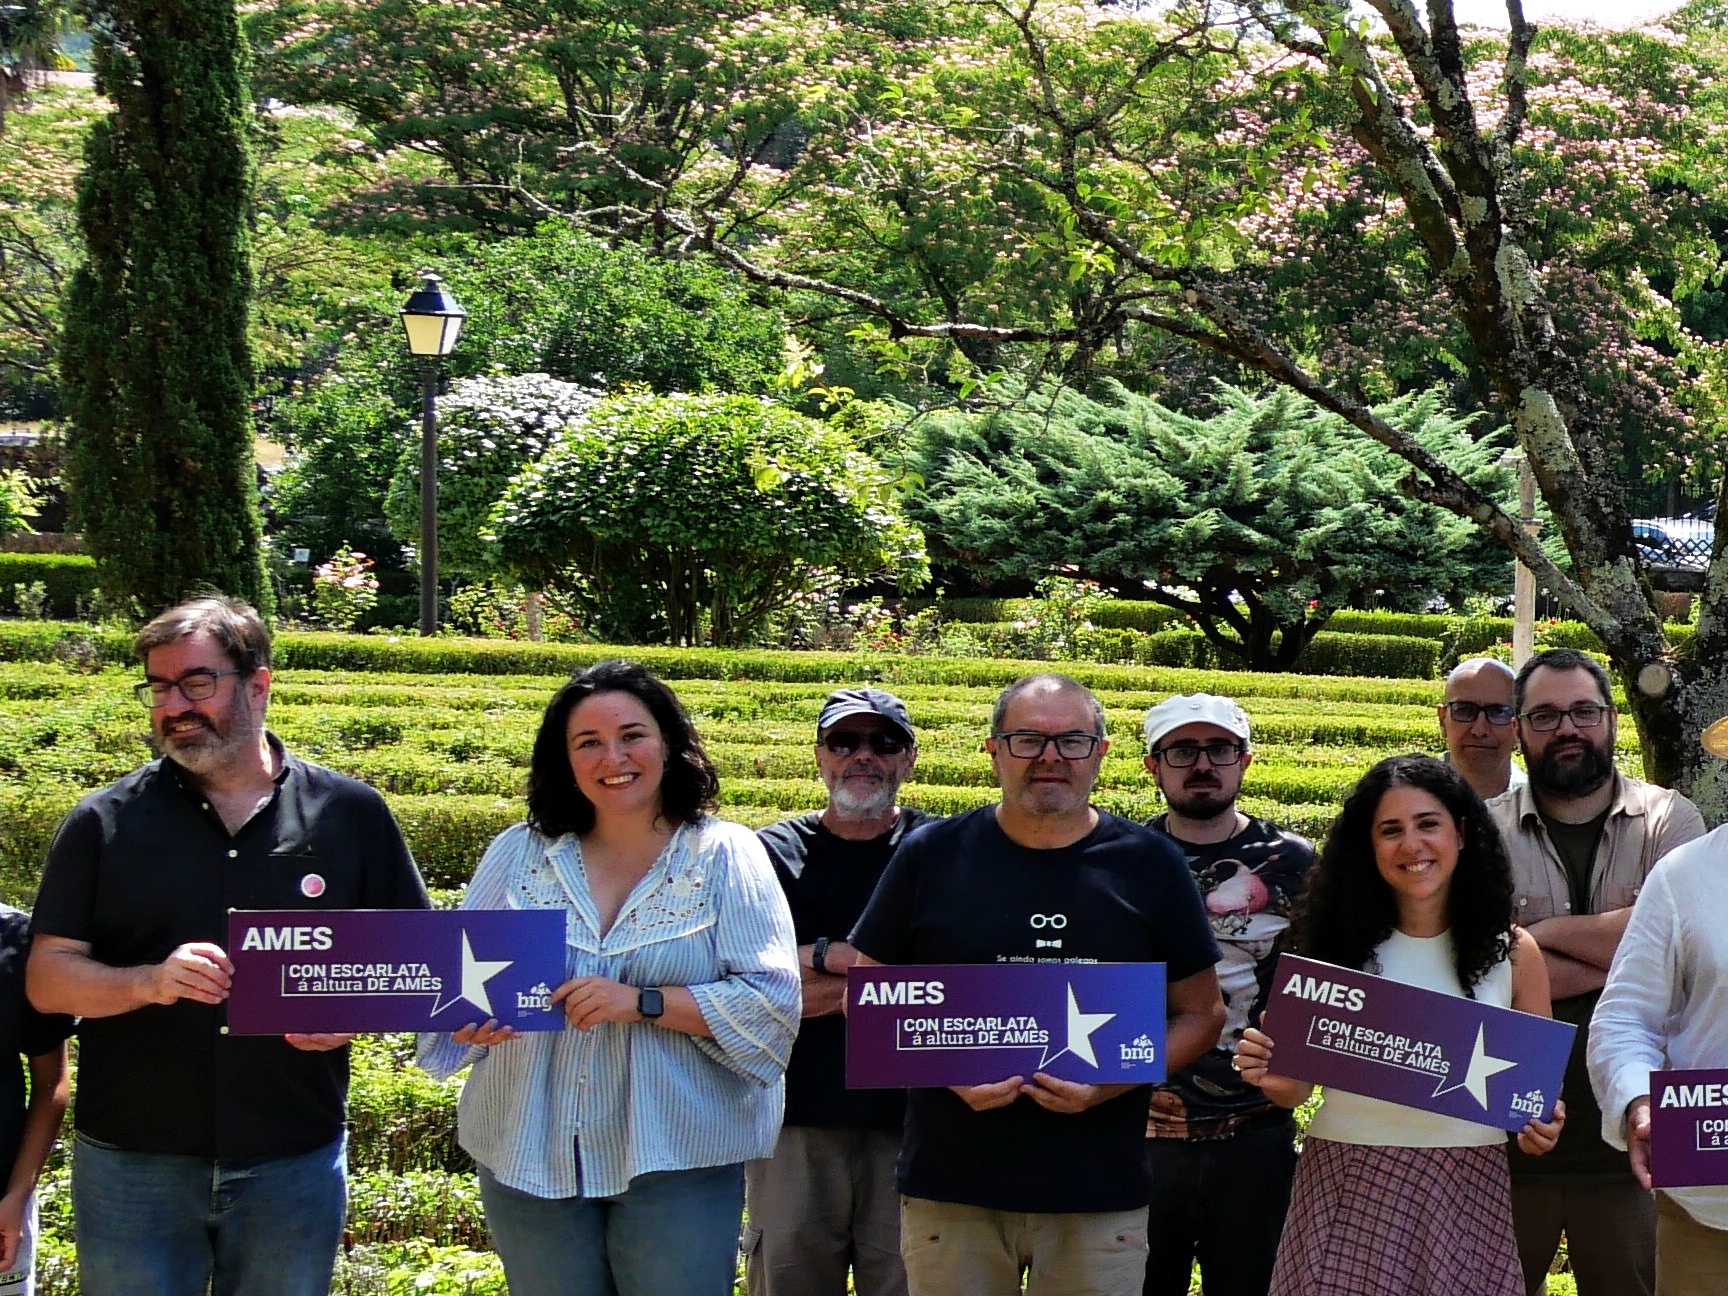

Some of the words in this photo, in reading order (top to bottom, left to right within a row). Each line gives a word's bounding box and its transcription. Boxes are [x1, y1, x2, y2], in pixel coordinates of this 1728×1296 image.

[242, 926, 332, 950] AMES
[289, 964, 326, 979] CON
[331, 963, 431, 977] ESCARLATA
[298, 978, 308, 991] á
[312, 978, 362, 991] altura
[367, 977, 389, 991] DE
[393, 977, 442, 990] AMES
[859, 981, 944, 1005] AMES
[1282, 974, 1365, 1011] AMES
[517, 991, 553, 1012] bng
[904, 1018, 939, 1033] CON
[943, 1016, 1038, 1031] ESCARLATA
[913, 1032, 922, 1045] á
[926, 1031, 974, 1045] altura
[978, 1031, 999, 1044] DE
[1003, 1030, 1049, 1043] AMES
[1318, 1018, 1352, 1036] CON
[1354, 1026, 1442, 1059] ESCARLATA
[1120, 1043, 1154, 1064] bng
[1322, 1032, 1332, 1046] á
[1335, 1037, 1380, 1057] altura
[1383, 1047, 1404, 1063] DE
[1405, 1053, 1450, 1074] AMES
[1510, 1093, 1544, 1118] bng
[1712, 1132, 1720, 1145] á
